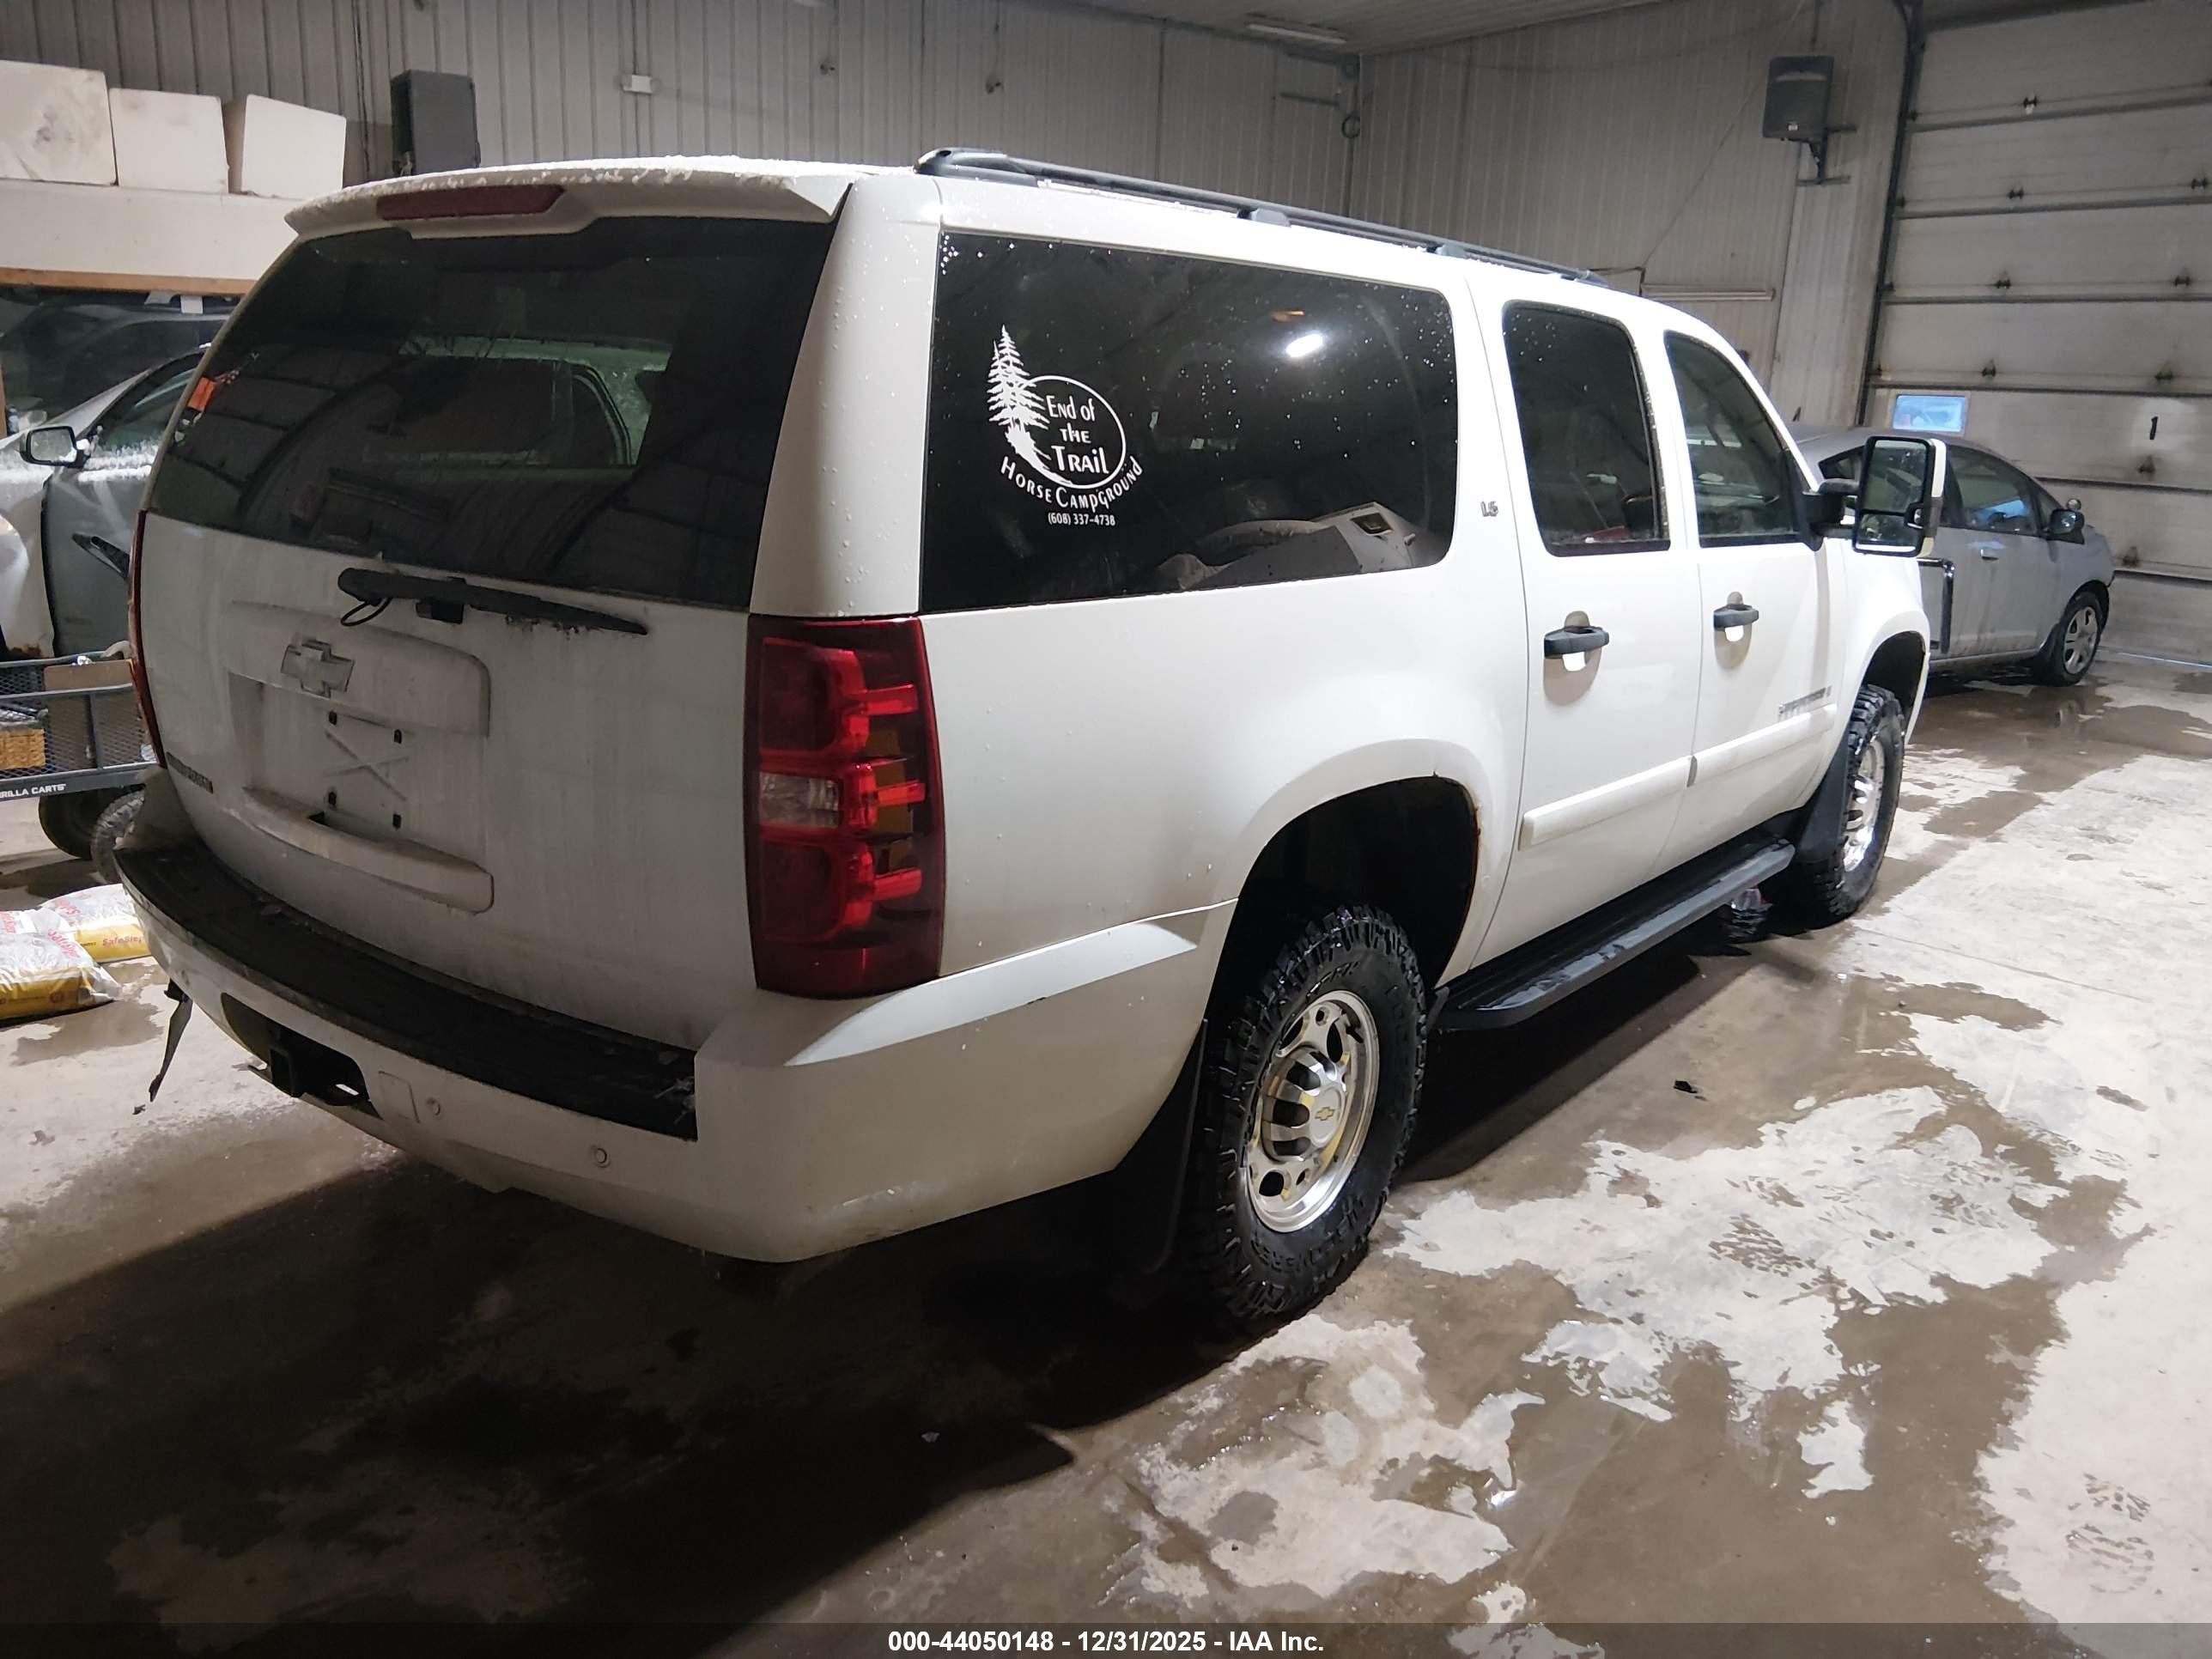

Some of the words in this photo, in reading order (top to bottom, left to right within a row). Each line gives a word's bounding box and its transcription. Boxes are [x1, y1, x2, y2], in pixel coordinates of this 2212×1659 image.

[1080, 398, 1095, 422] of
[2149, 416, 2158, 441] 1
[1048, 512, 1072, 526] (608)
[1073, 513, 1115, 526] 337-4738
